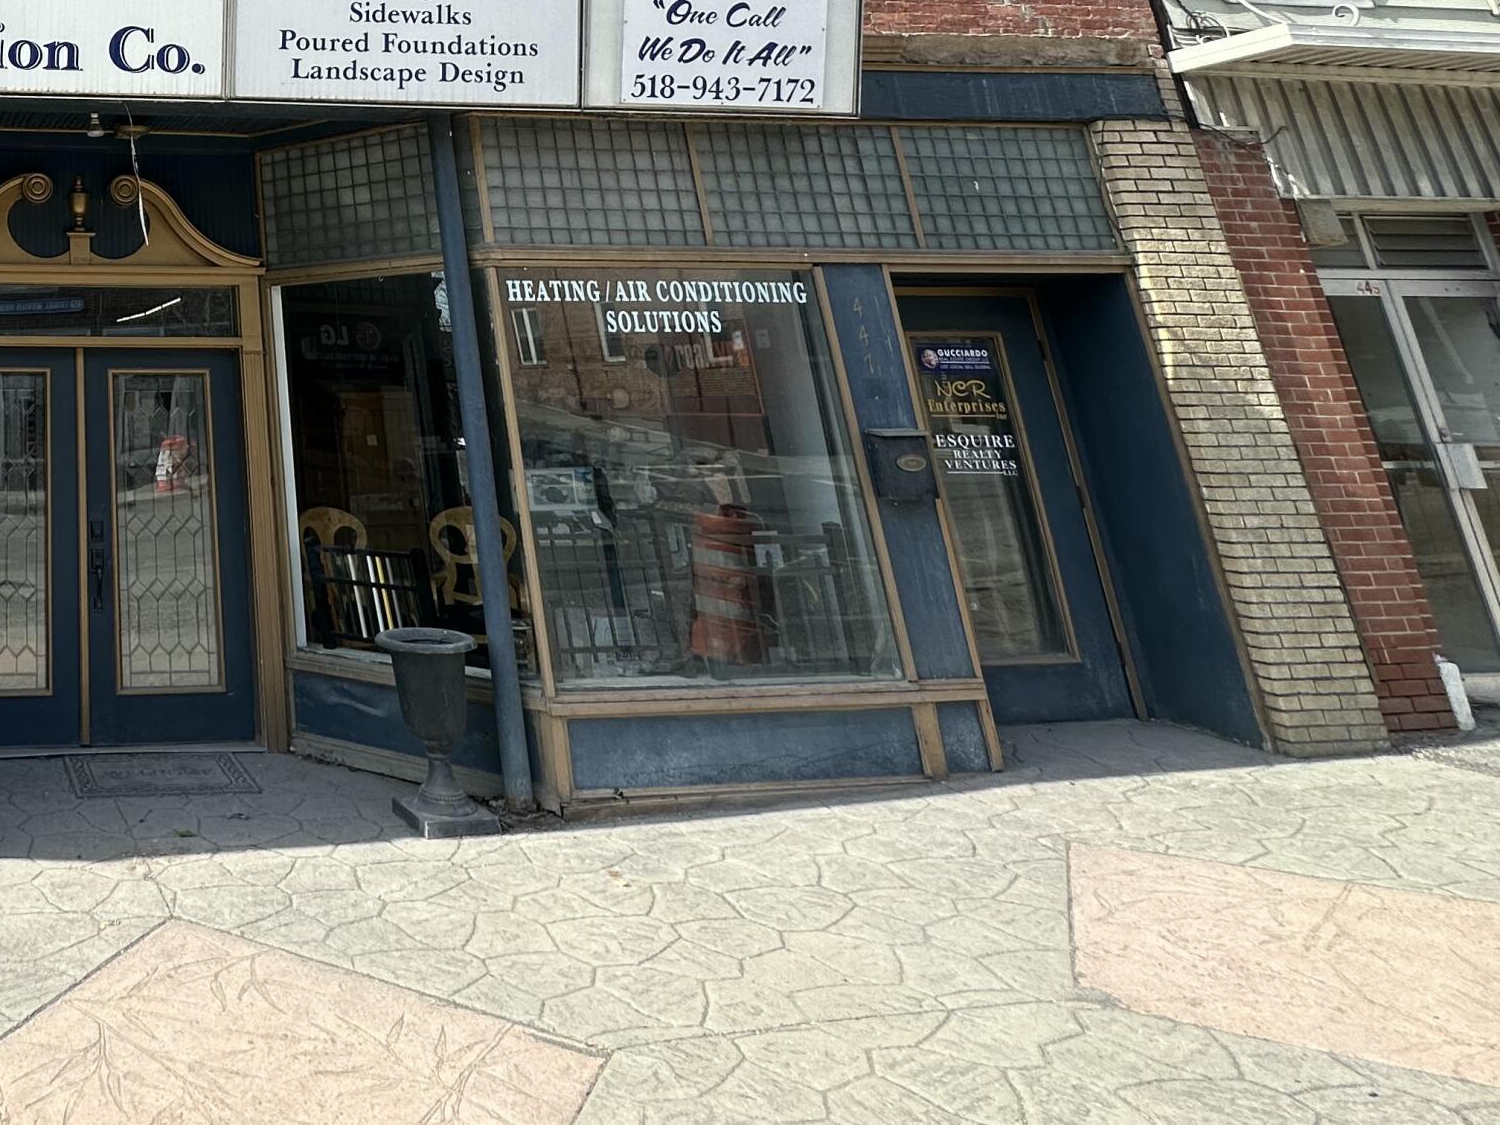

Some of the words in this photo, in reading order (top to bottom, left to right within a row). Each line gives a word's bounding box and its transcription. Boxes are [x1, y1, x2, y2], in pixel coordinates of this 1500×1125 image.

[350, 2, 471, 25] Sidewalks
[653, 0, 717, 25] “One
[726, 2, 786, 27] Call
[109, 26, 205, 74] Co.
[279, 30, 369, 52] Poured
[382, 33, 538, 56] Foundations
[639, 36, 673, 61] We
[678, 38, 715, 63] Do
[722, 40, 746, 65] It
[747, 42, 812, 67] All”
[292, 58, 426, 89] Landscape
[439, 62, 524, 91] Design
[631, 74, 815, 104] 518-943-7172
[506, 280, 601, 302] HEATING
[615, 281, 652, 302] AIR
[656, 281, 808, 304] CONDITIONING
[606, 311, 722, 333] SOLUTIONS
[937, 349, 988, 357] GUCCIARDO
[935, 380, 991, 399] NCR
[928, 399, 1005, 414] Enterprises
[936, 434, 1015, 449] ESQUIRE
[945, 460, 1017, 470] VENTURES
[953, 450, 1002, 459] REALTY
